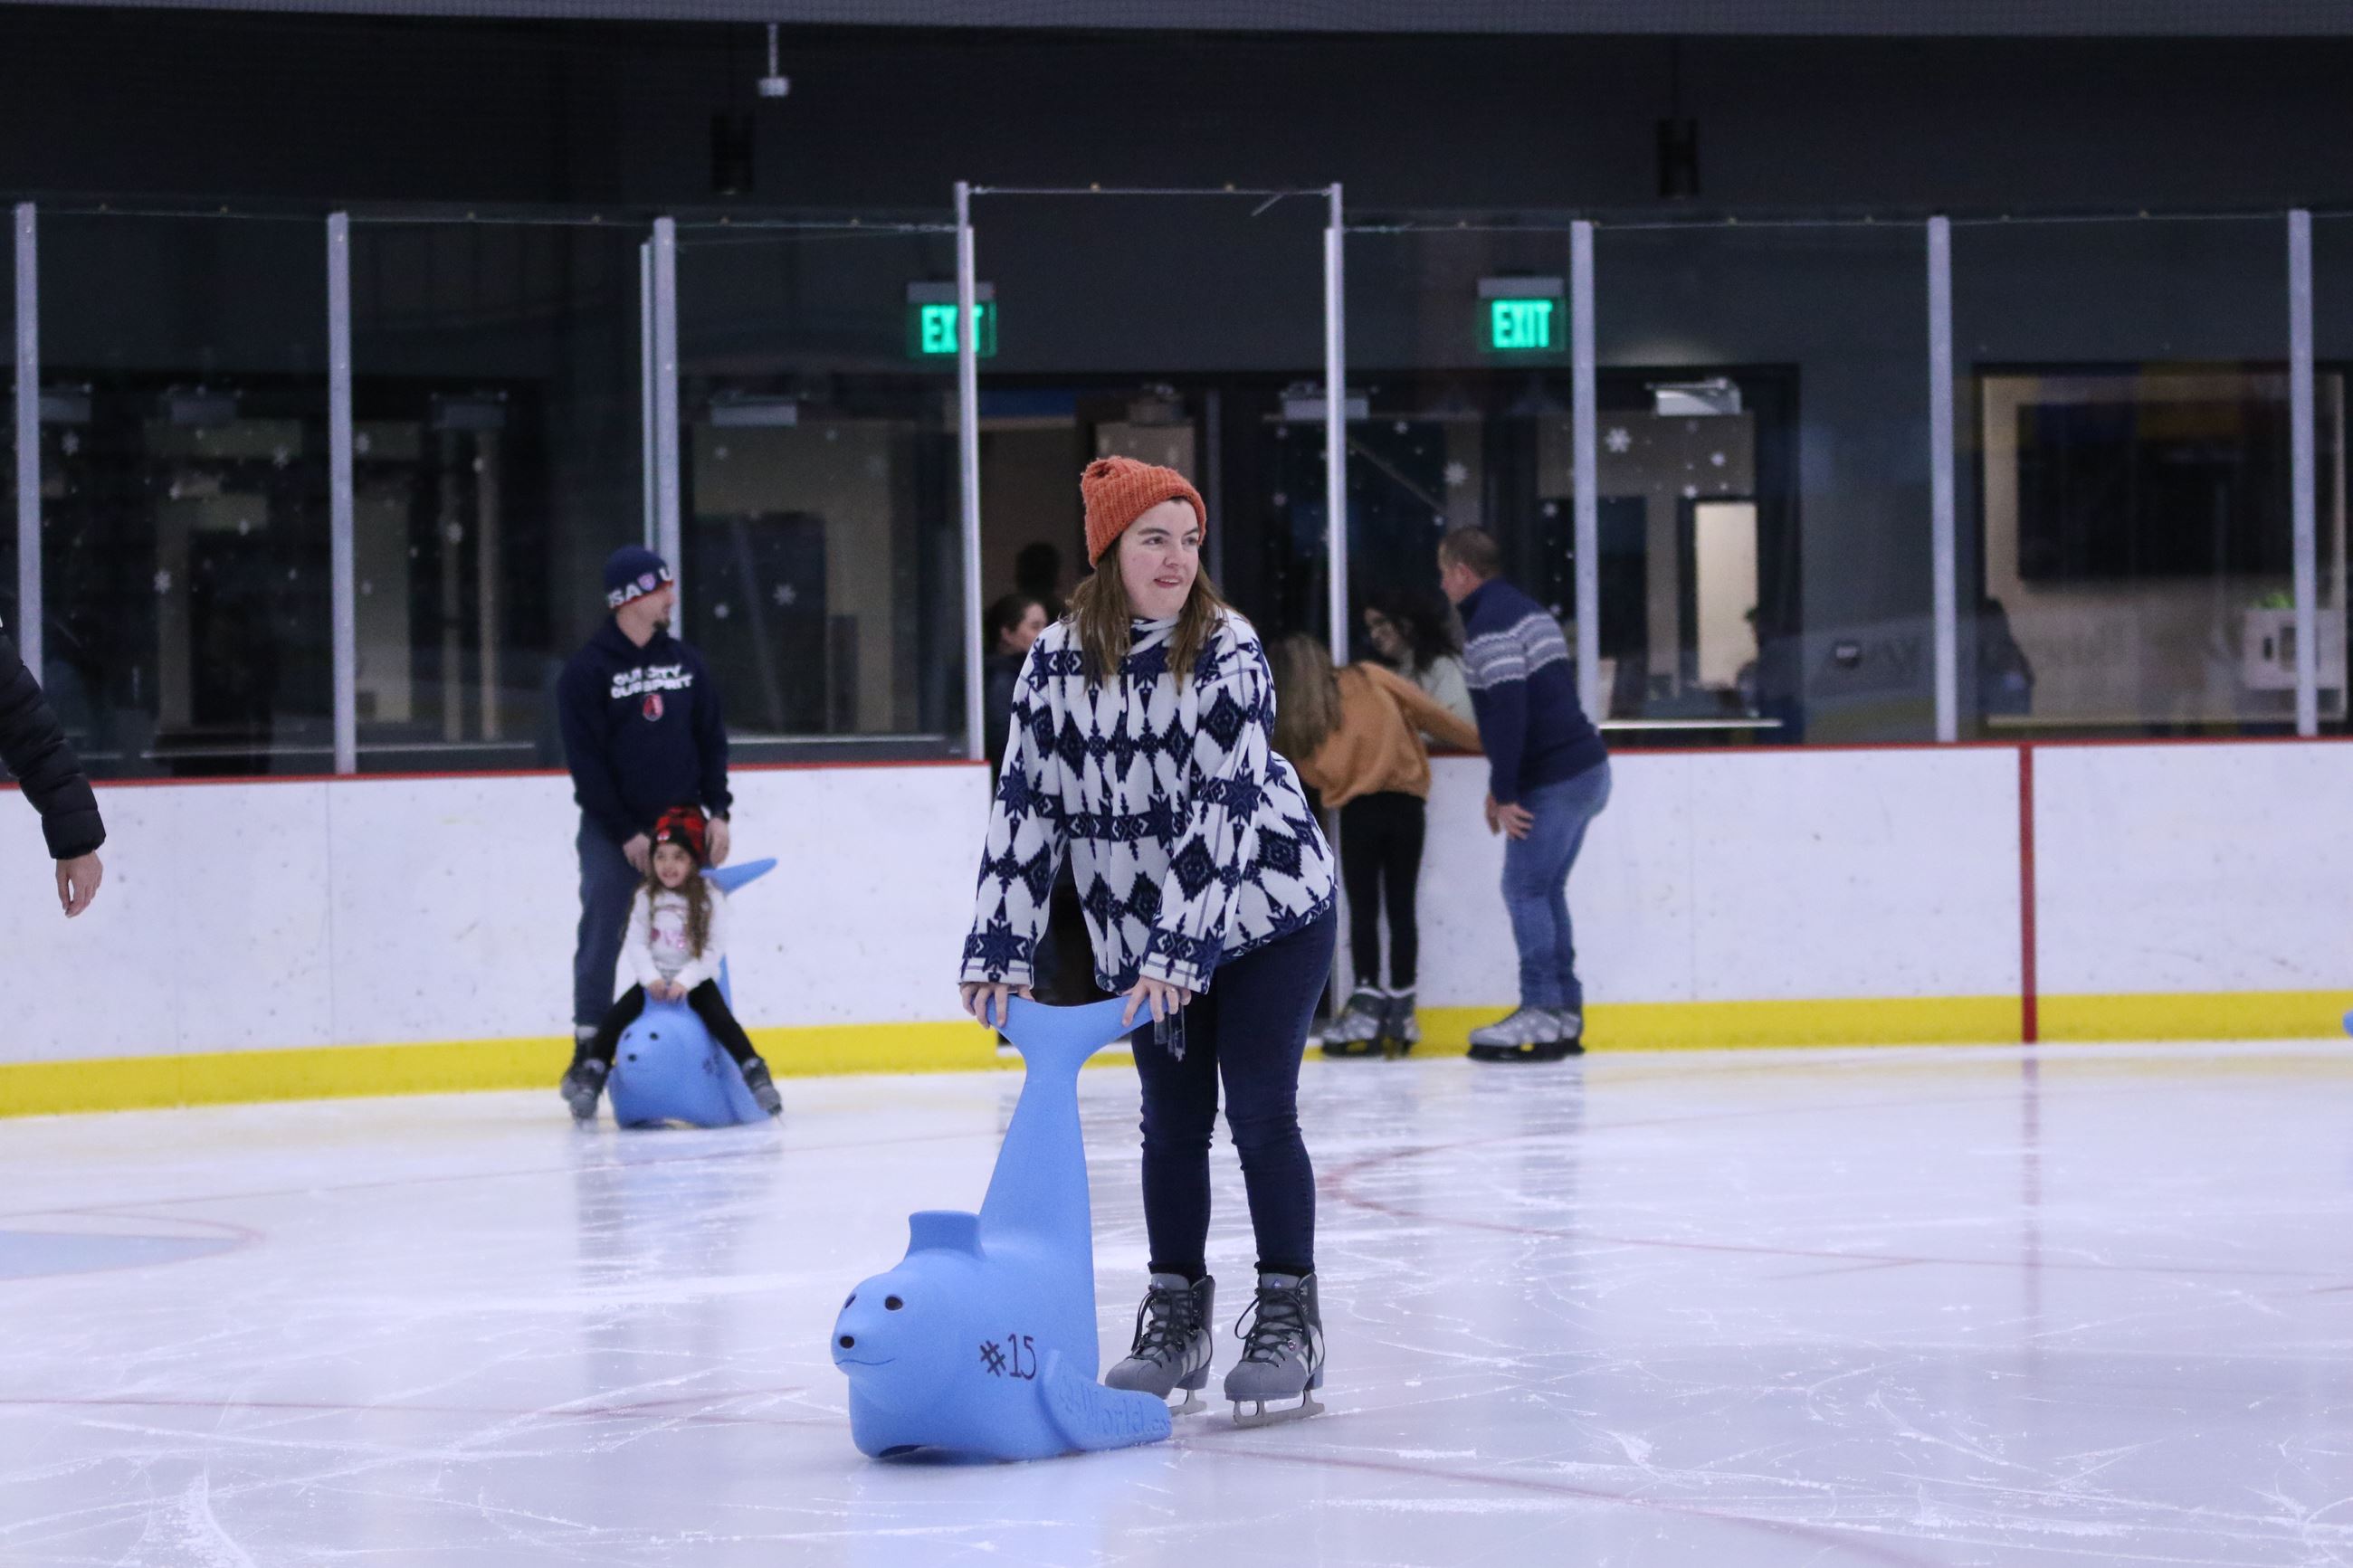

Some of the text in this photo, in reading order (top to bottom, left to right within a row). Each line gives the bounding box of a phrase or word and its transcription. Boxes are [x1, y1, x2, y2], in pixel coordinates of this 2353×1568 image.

[921, 304, 984, 353] EXT
[1491, 299, 1553, 348] EXIT
[979, 1333, 1036, 1381] #15
